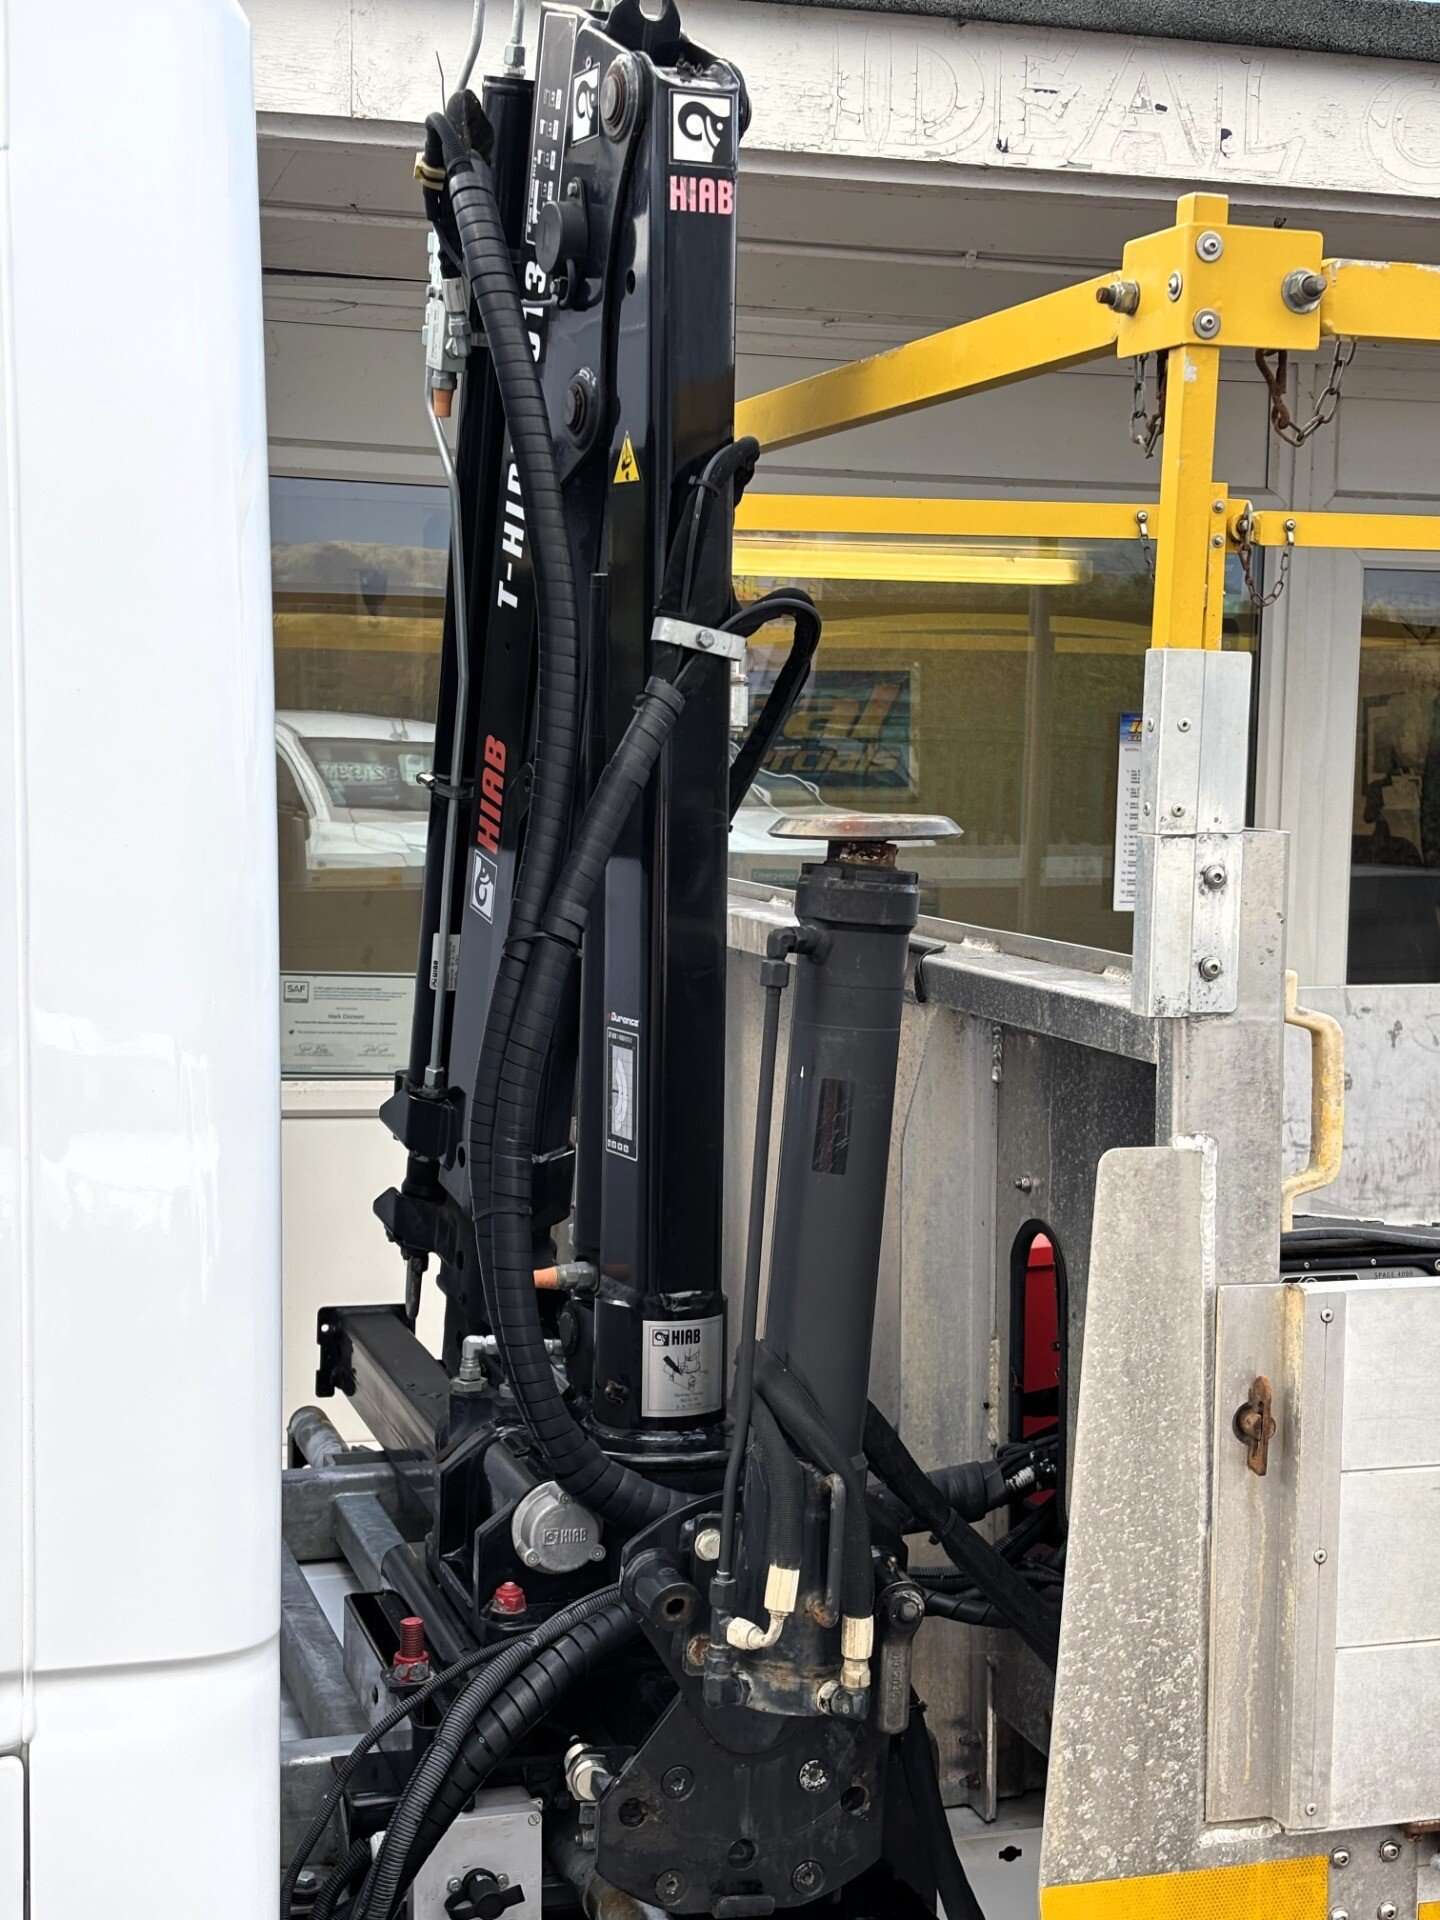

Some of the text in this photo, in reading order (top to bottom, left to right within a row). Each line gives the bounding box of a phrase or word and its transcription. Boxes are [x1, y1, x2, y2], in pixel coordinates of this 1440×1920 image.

[669, 175, 733, 215] HIAB
[477, 734, 507, 855] HIAB
[671, 1328, 701, 1346] HIAB
[560, 1527, 588, 1544] HIAB
